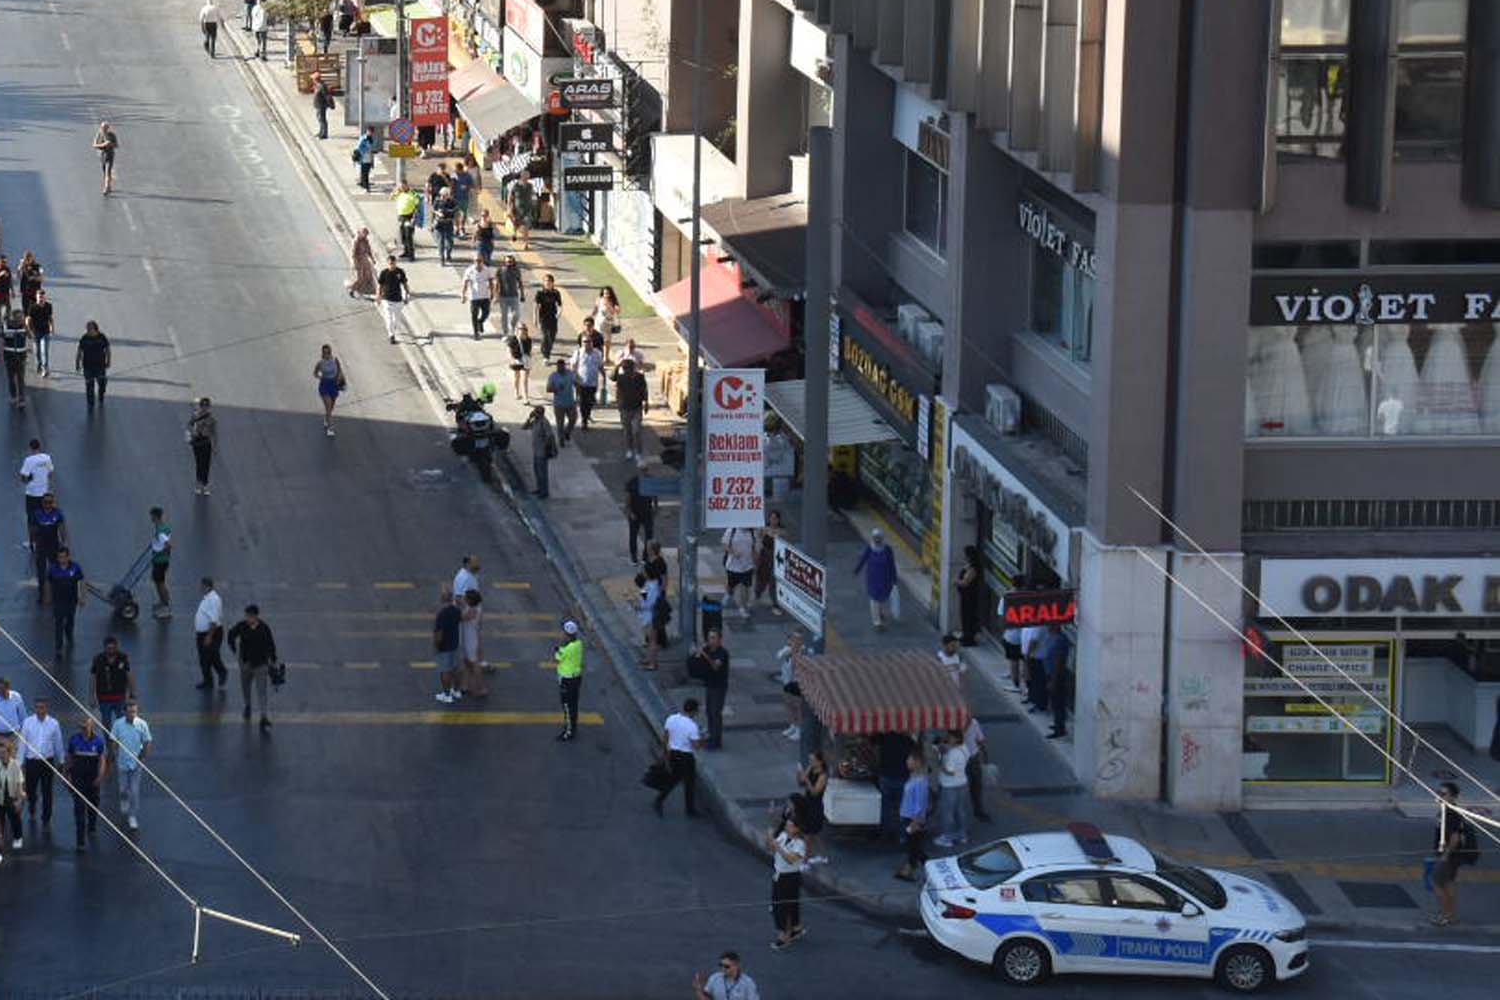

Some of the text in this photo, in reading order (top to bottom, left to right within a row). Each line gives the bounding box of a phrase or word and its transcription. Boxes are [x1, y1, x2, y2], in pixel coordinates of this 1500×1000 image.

[565, 85, 611, 93] ARAS
[567, 140, 606, 150] iPhone
[1464, 293, 1500, 320] F
[709, 434, 758, 450] Reklam
[712, 477, 755, 495] 0 232
[1301, 575, 1463, 613] ODAK
[1120, 943, 1159, 955] TRAFİK
